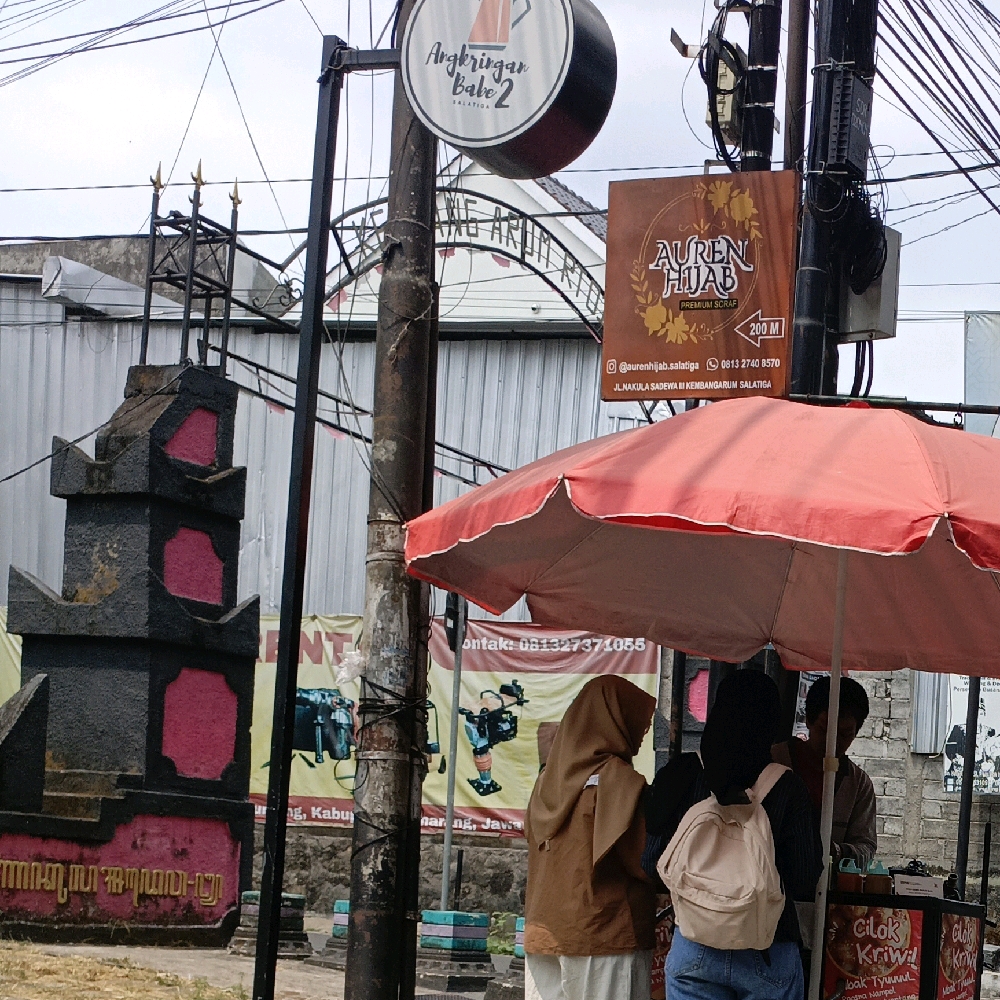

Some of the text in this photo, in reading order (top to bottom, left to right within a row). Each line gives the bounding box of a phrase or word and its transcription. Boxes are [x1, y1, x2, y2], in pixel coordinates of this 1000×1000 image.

[425, 41, 530, 84] Angkringan
[451, 72, 514, 109] Babe 2
[452, 99, 490, 109] SALATIGA
[491, 205, 552, 269] ARUM
[649, 235, 754, 272] AUREN
[662, 264, 738, 299] HIJAB
[680, 300, 737, 311] PREMIUM SCRAF
[750, 322, 779, 336] 200 M
[619, 357, 780, 374] @aurenhijab.salatiga 0813 2740 8570
[650, 381, 678, 391] SADEWA
[686, 380, 737, 390] KEMBANGARUM
[740, 379, 772, 389] SALATIGA
[462, 637, 646, 652] ontak: 081327371055
[845, 976, 868, 991] bak
